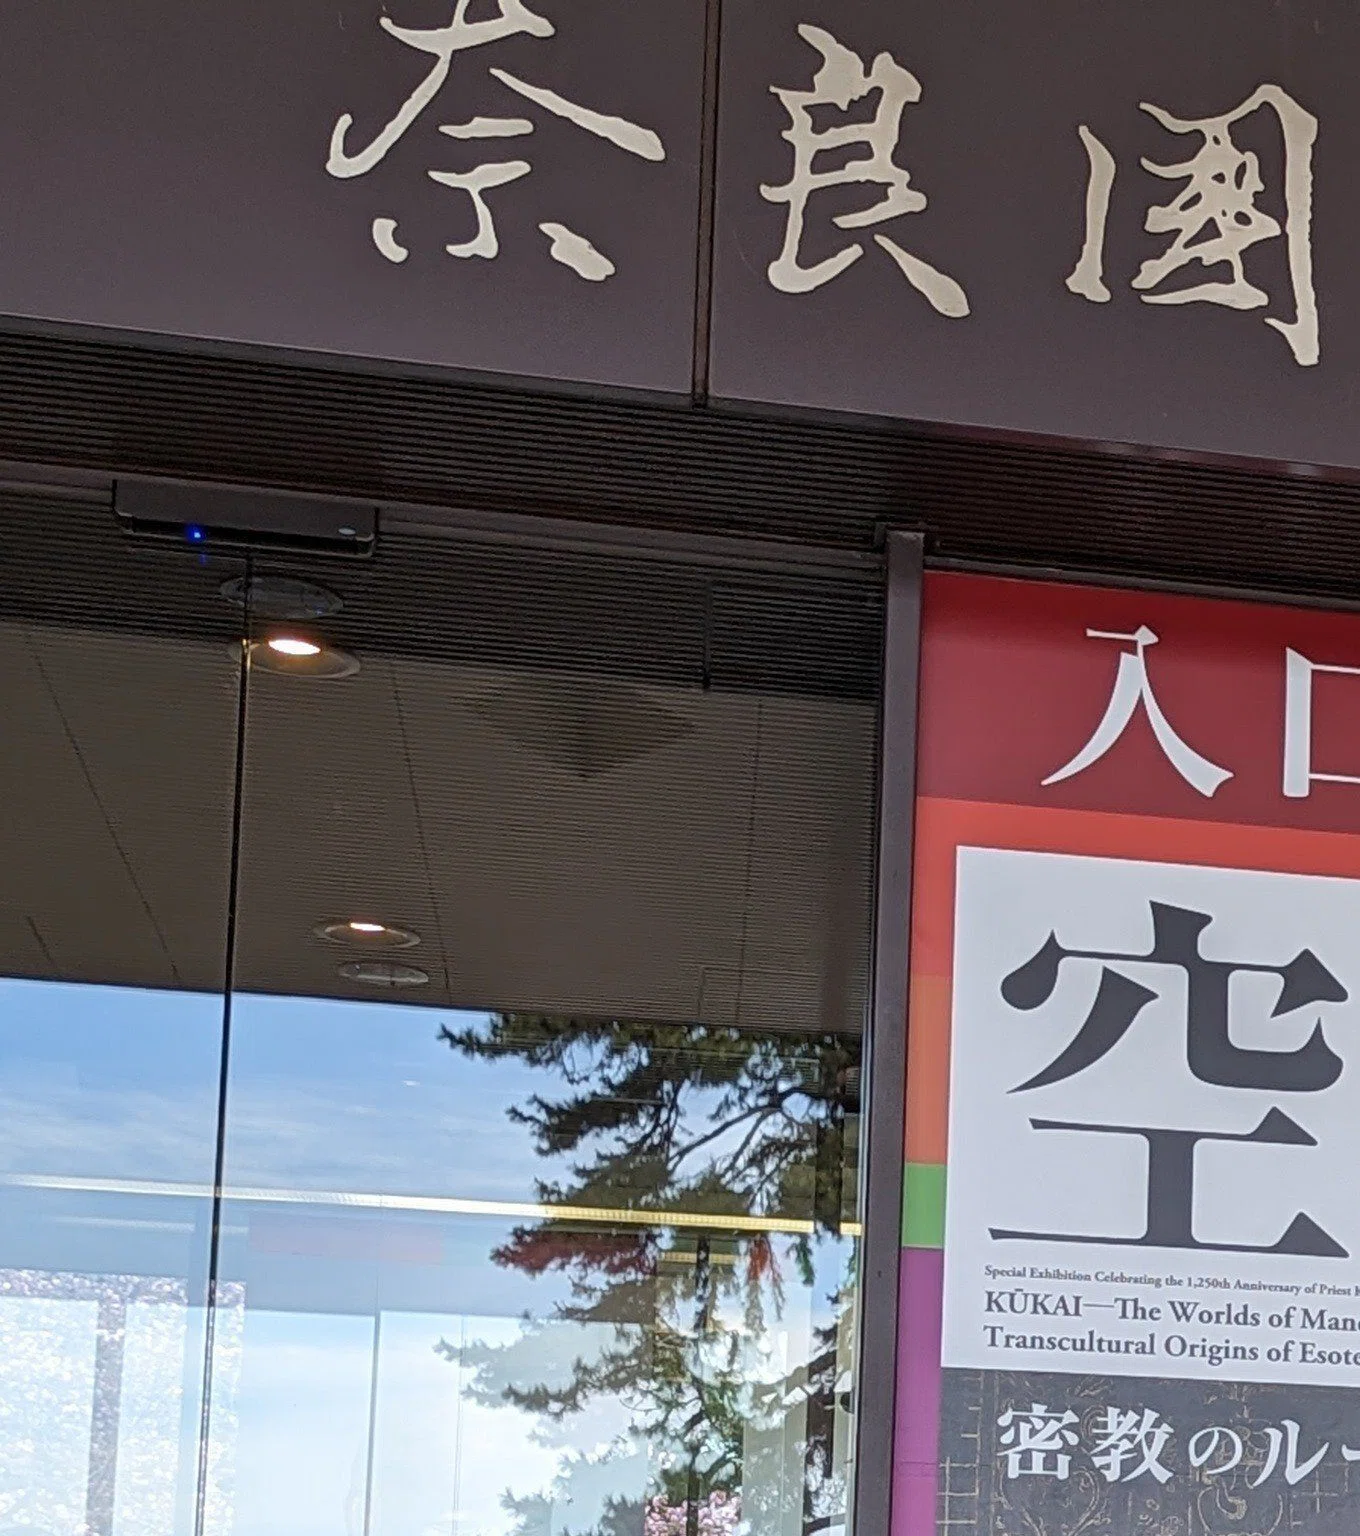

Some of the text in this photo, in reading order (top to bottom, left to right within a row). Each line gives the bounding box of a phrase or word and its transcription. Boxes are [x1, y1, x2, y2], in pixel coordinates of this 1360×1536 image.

[984, 1264, 1027, 1280] Special
[1029, 1266, 1092, 1282] Exhibition
[1093, 1270, 1163, 1289] Celebrating
[1164, 1274, 1184, 1287] the
[1187, 1276, 1232, 1291] 1,250th
[1233, 1278, 1304, 1298] Anniversary
[1304, 1282, 1319, 1295] of
[1319, 1282, 1353, 1298] Priest
[984, 1287, 1162, 1322] KŪKAI—The
[1166, 1300, 1261, 1327] Worlds
[1268, 1305, 1298, 1329] of
[982, 1324, 1156, 1356] Transcultural
[1163, 1334, 1259, 1367] Origins
[1266, 1339, 1296, 1363] of
